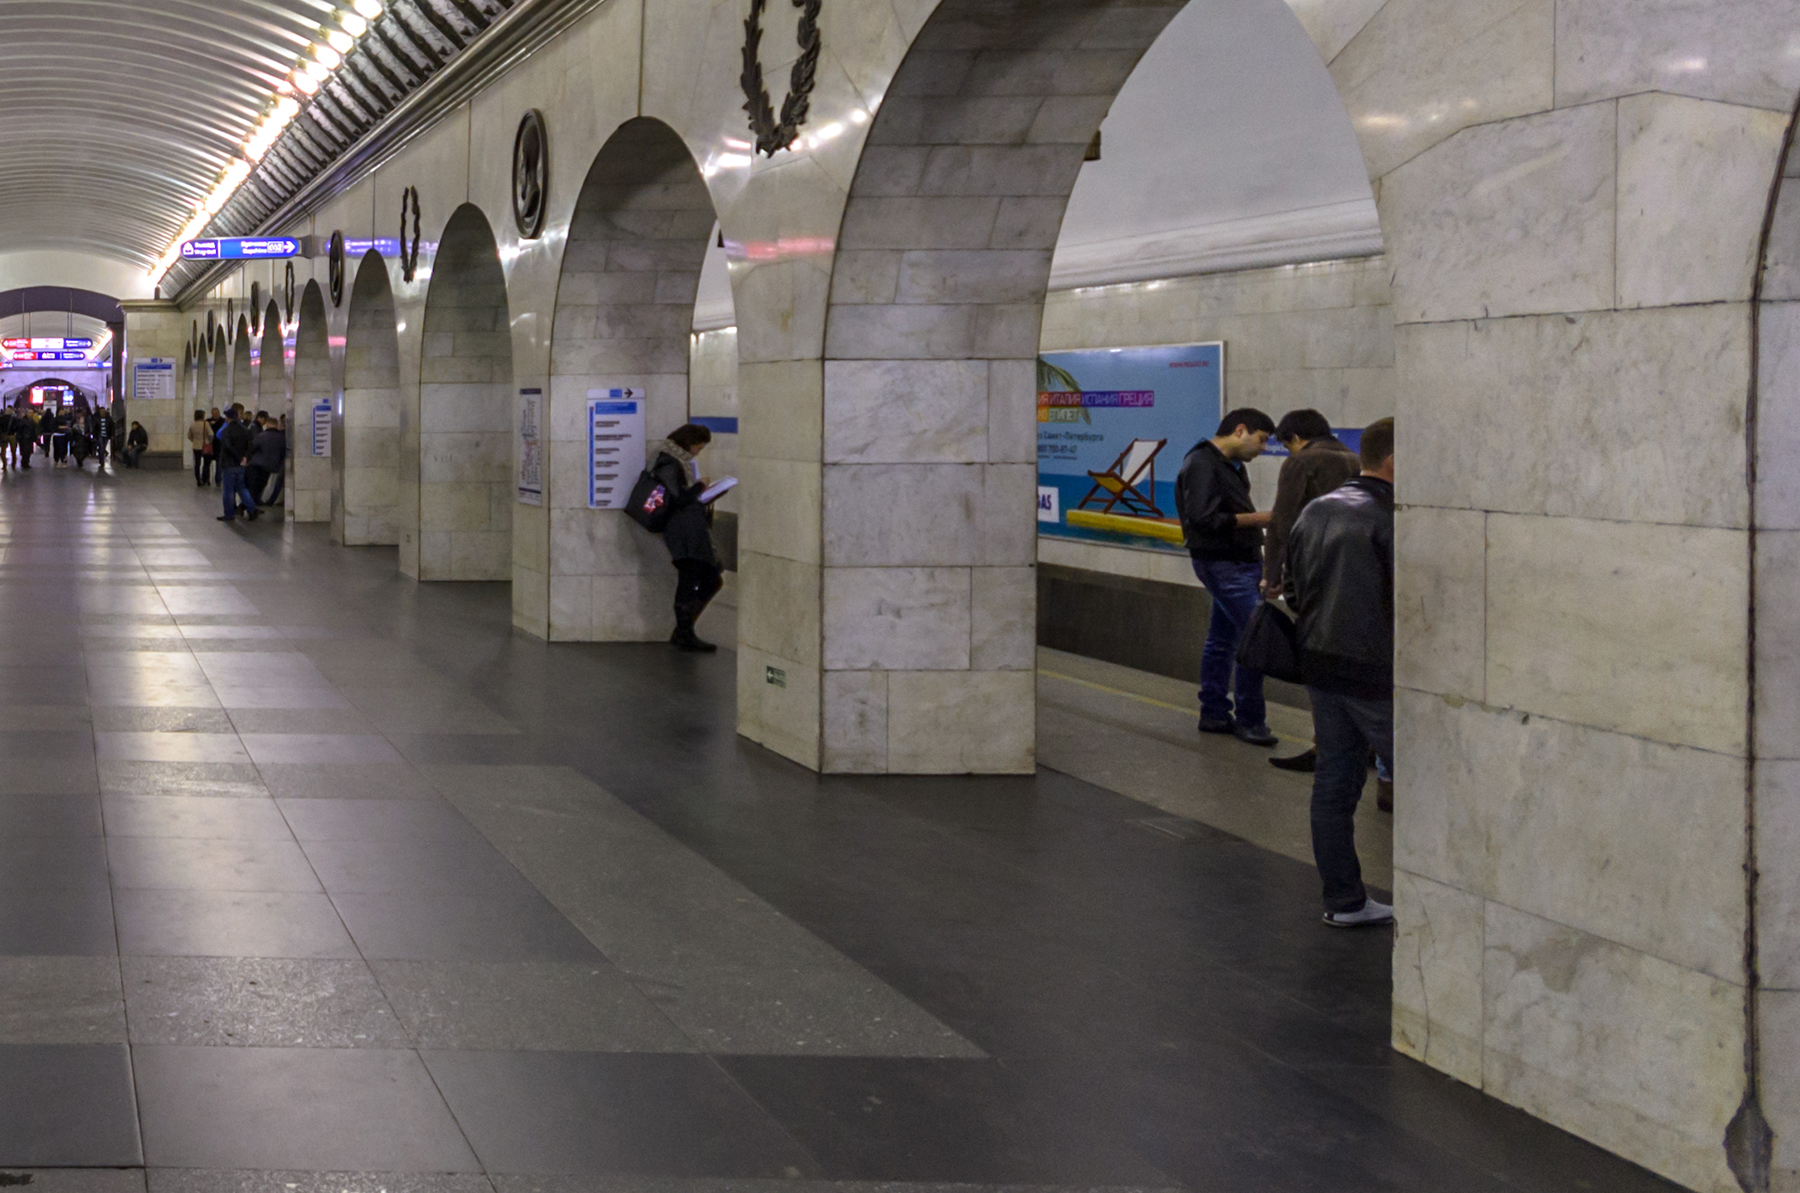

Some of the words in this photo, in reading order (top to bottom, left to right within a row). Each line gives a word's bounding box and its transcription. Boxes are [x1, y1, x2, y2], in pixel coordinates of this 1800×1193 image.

[1051, 393, 1082, 405] ИТАЛИЯ
[1082, 393, 1119, 405] ИСПАНИЯ
[1119, 392, 1154, 406] ГРЕЦИЯ
[1049, 409, 1078, 421] ЕГИПЕТ
